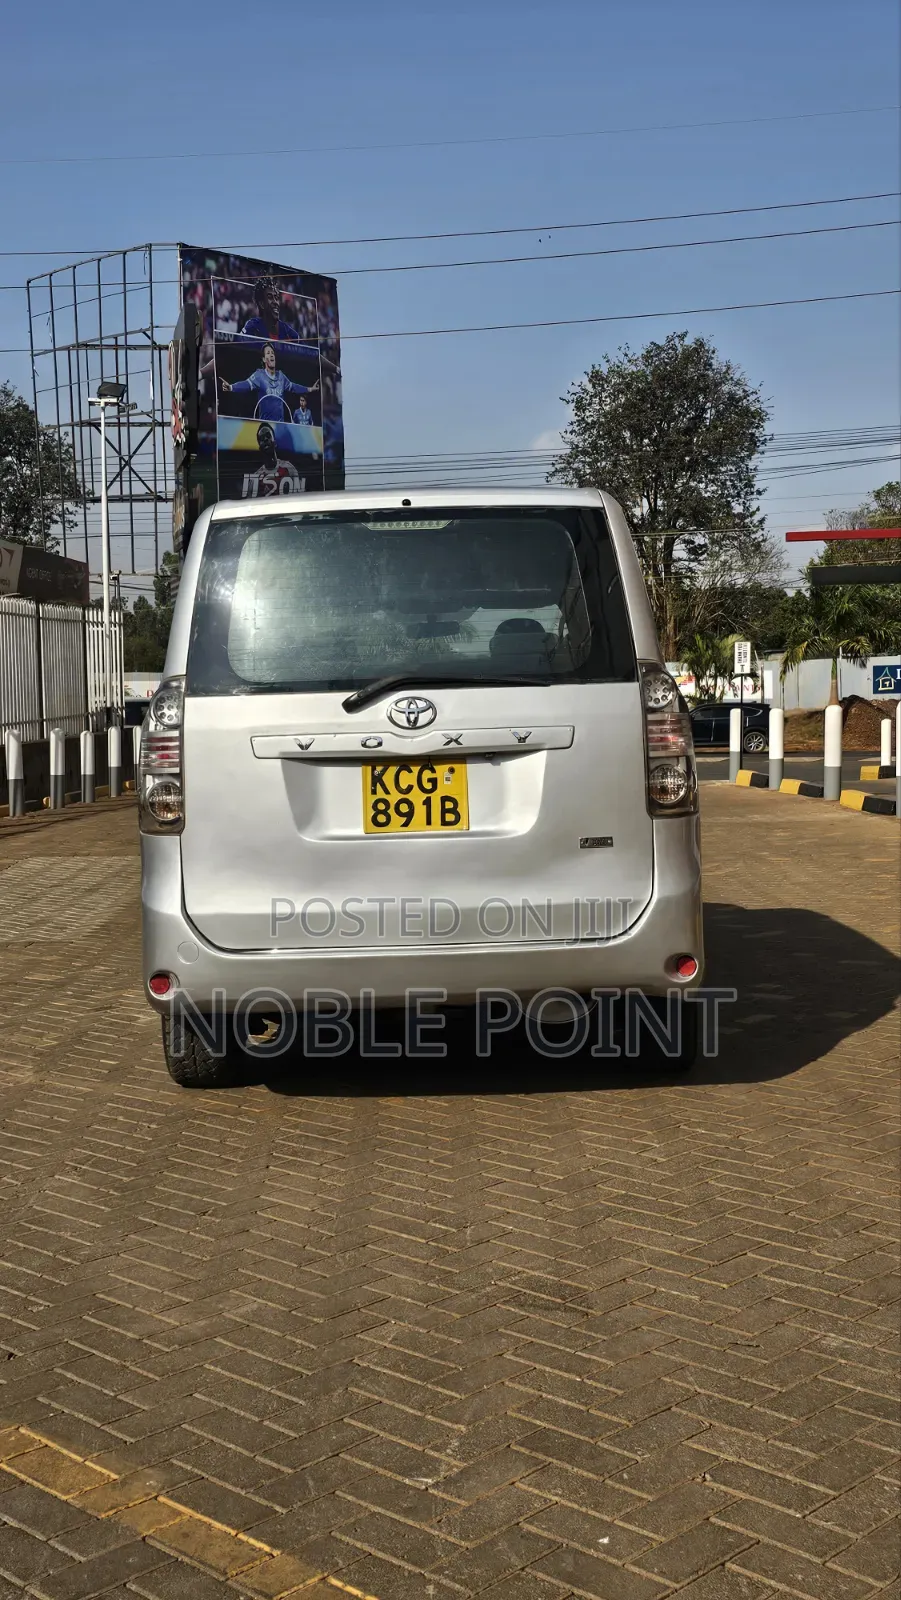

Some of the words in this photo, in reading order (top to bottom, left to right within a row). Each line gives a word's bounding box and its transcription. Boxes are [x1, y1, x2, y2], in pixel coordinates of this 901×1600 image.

[293, 730, 533, 751] VOXY
[370, 764, 438, 795] KCG
[371, 795, 461, 828] 891B
